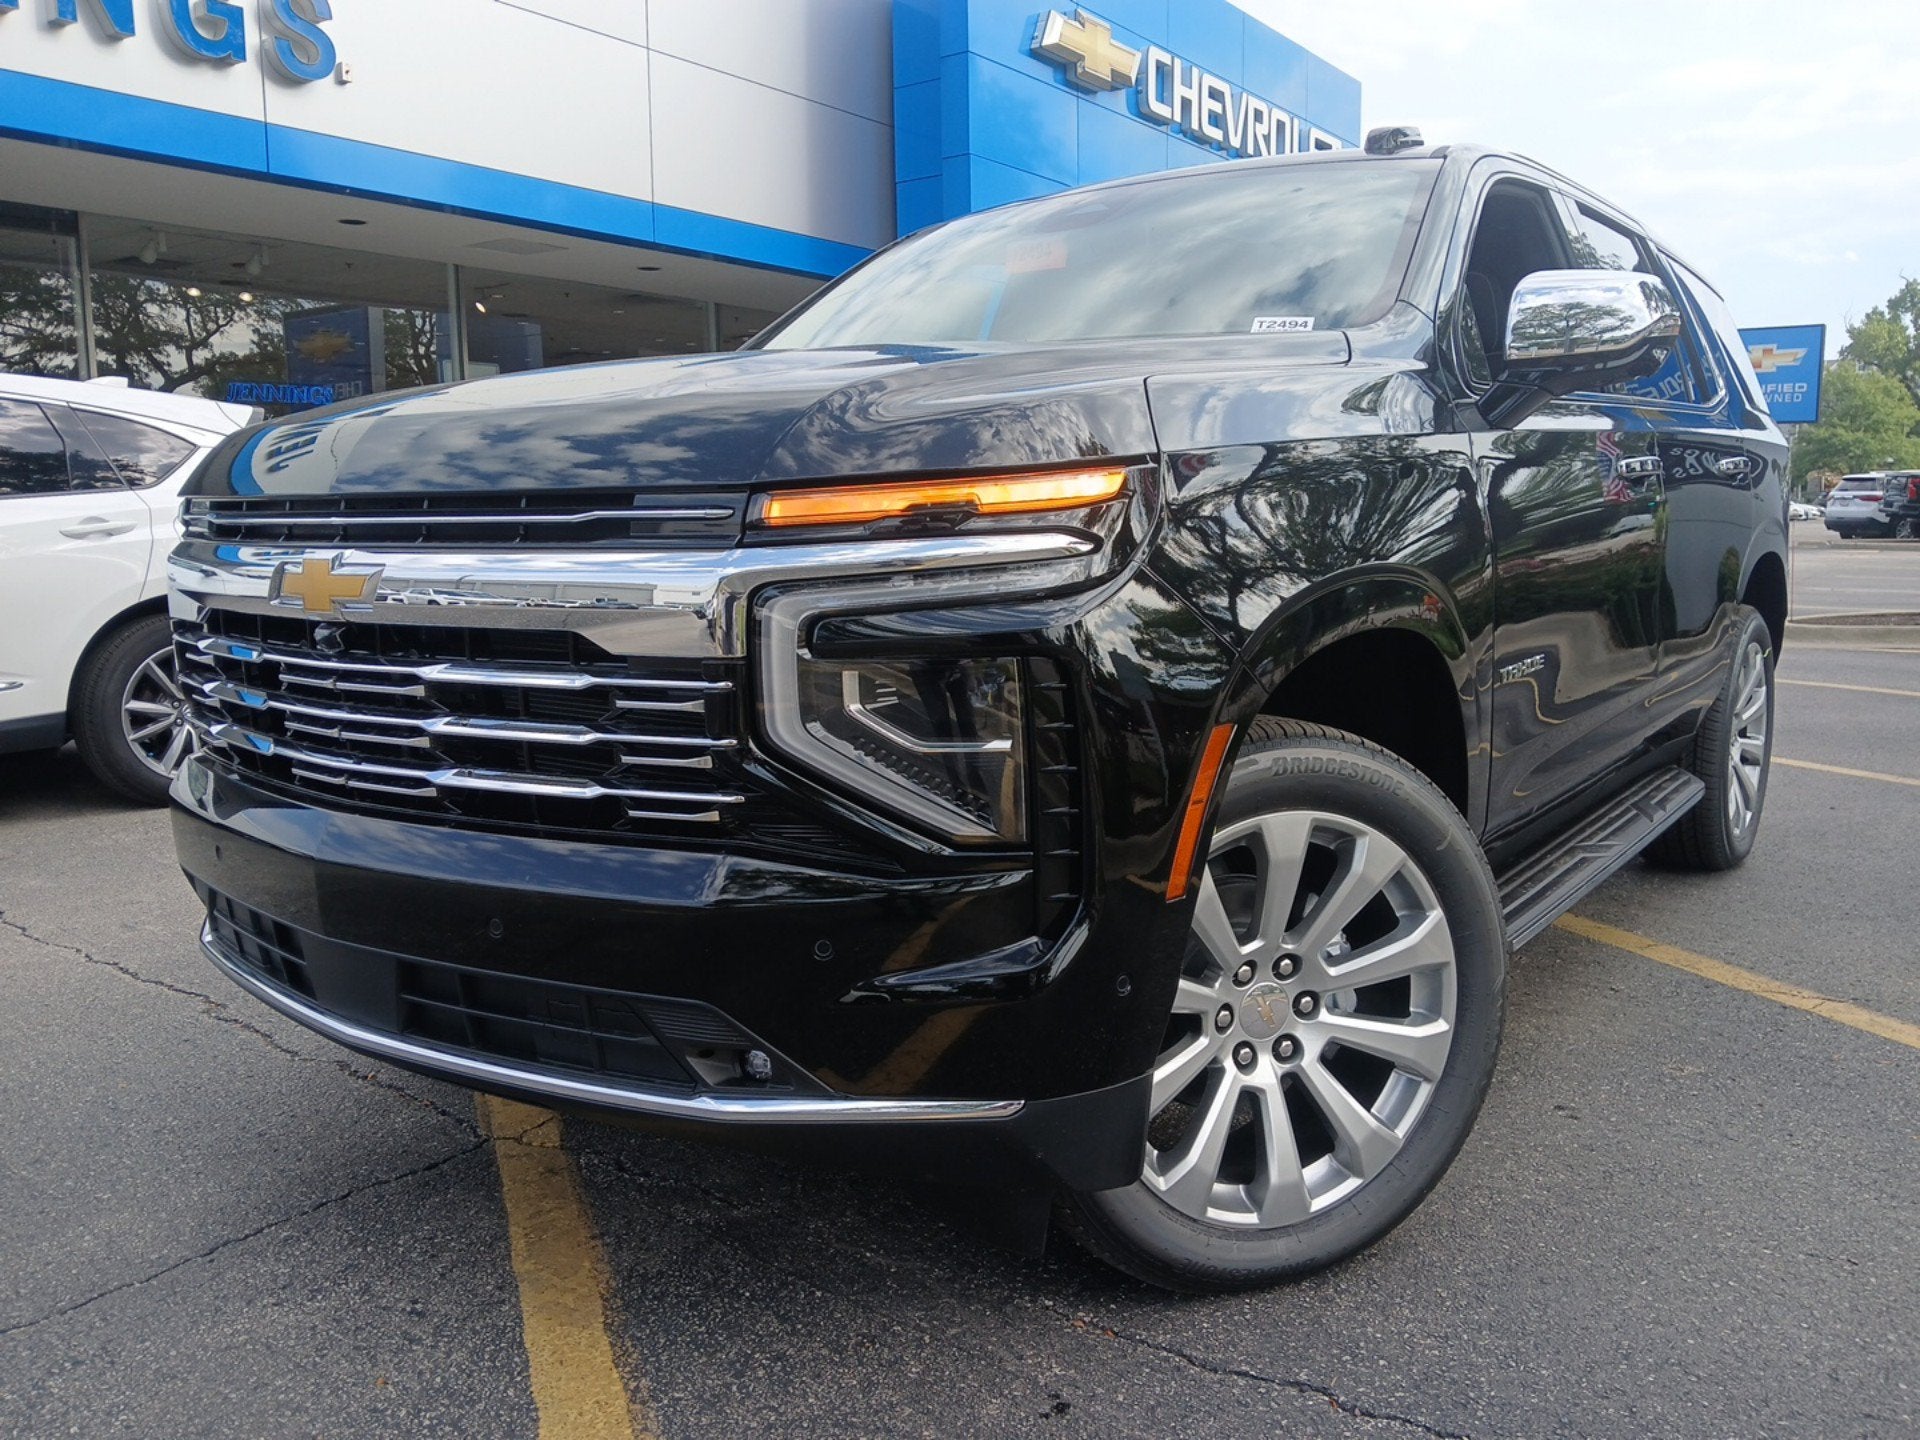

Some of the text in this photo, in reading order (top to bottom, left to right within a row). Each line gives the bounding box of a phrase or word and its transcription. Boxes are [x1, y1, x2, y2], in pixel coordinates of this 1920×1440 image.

[1144, 45, 1343, 157] CHEVROL
[1256, 319, 1309, 329] T2494
[226, 382, 334, 405] JENNINGS
[1499, 653, 1545, 685] TAHOE
[1268, 756, 1407, 798] BRIDGESTONE
